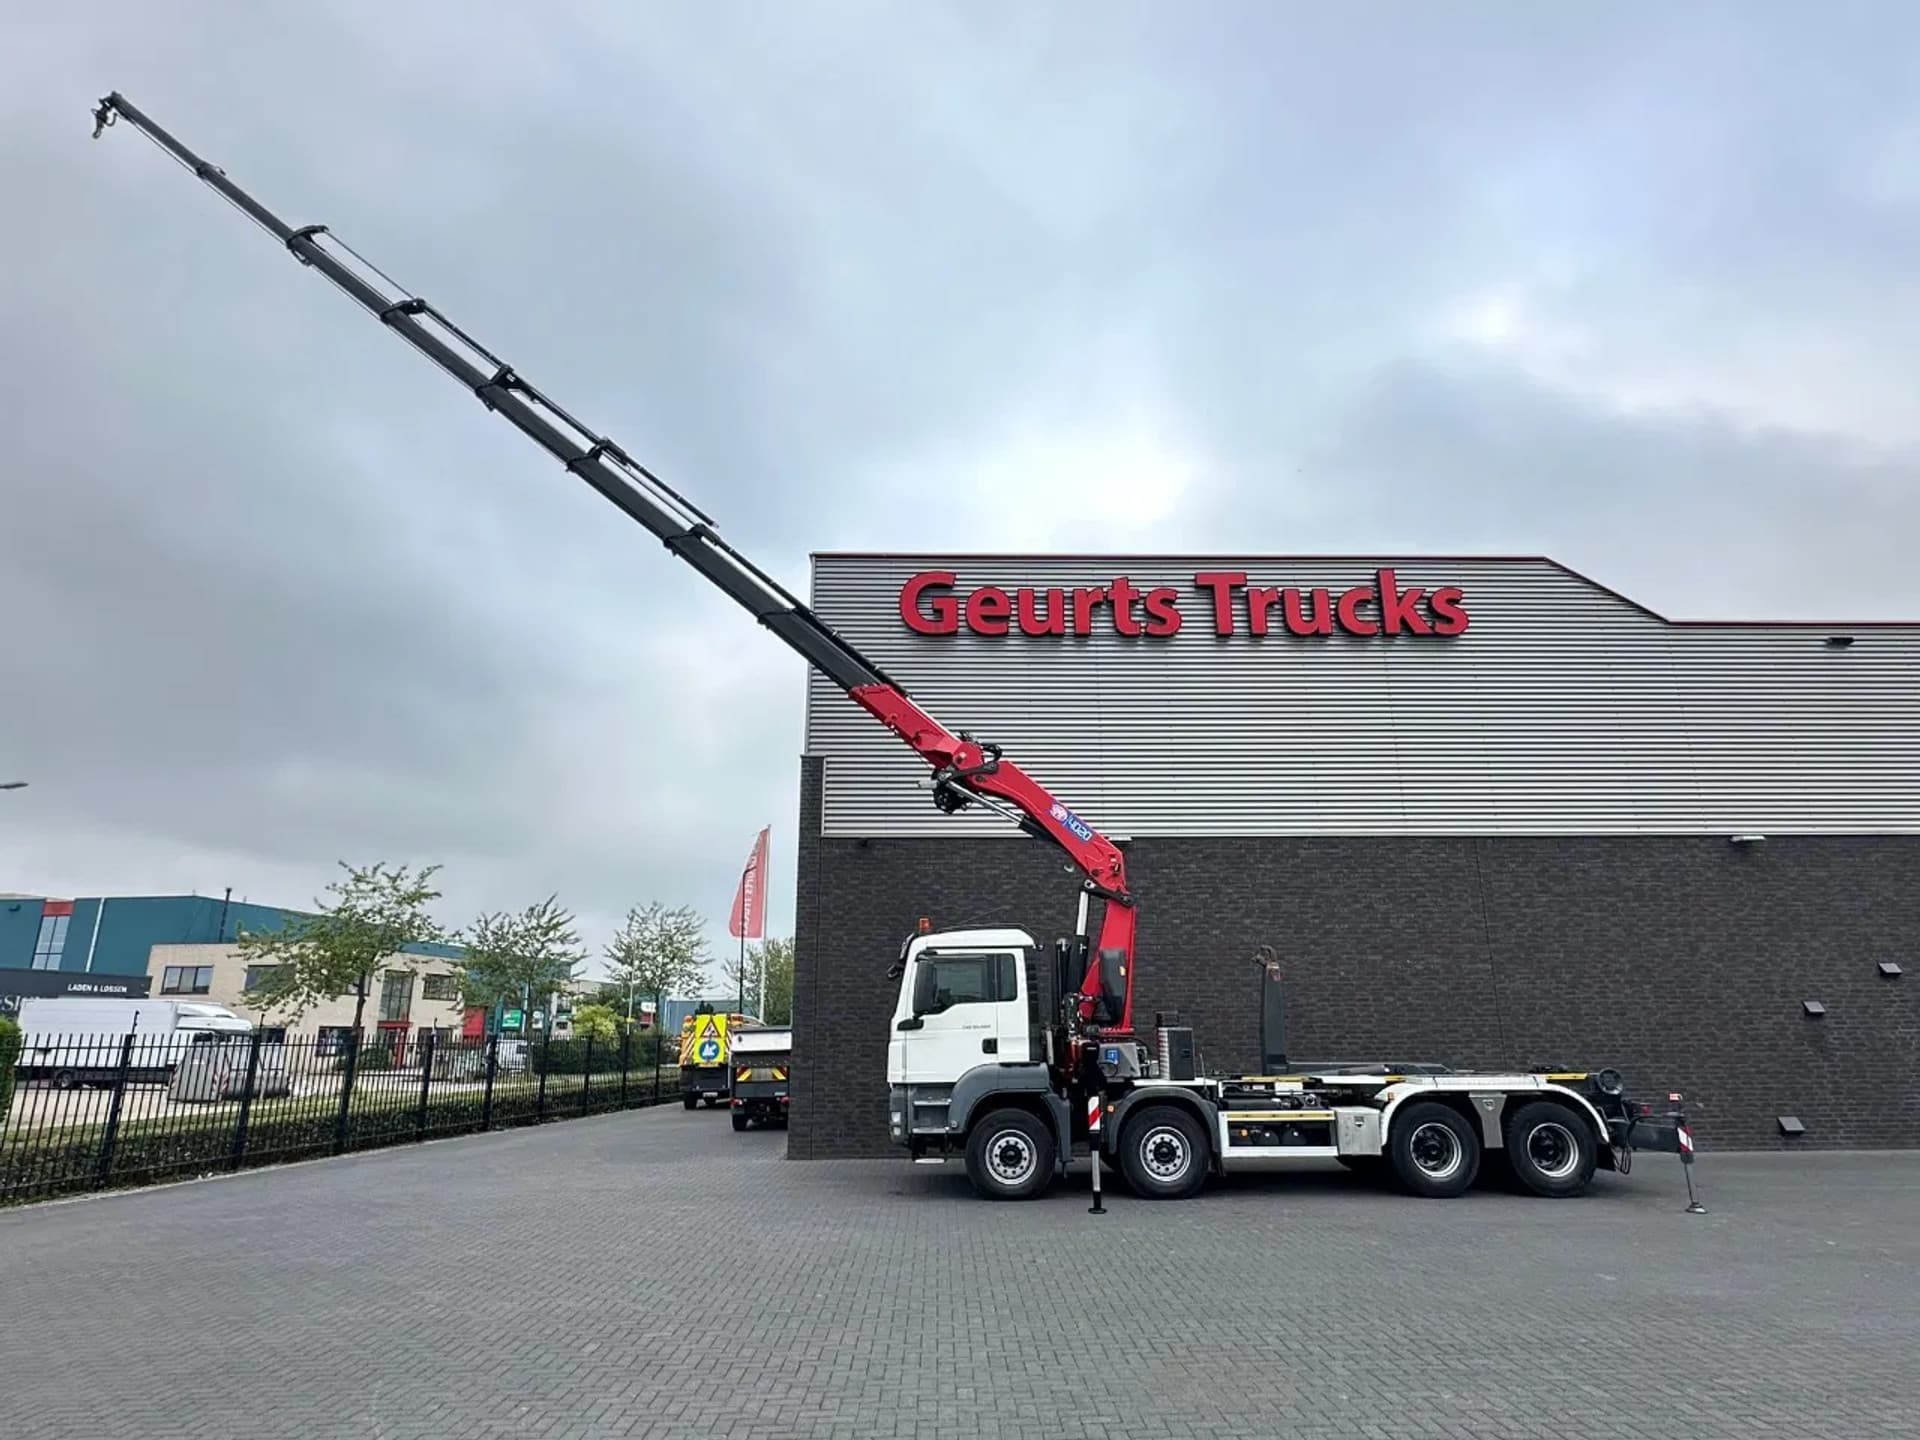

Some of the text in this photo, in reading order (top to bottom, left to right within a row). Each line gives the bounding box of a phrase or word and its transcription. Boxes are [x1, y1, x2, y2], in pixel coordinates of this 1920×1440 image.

[900, 568, 1470, 636] Geurts Trucks
[67, 983, 92, 992] LADEN
[100, 984, 128, 993] LOSSEN
